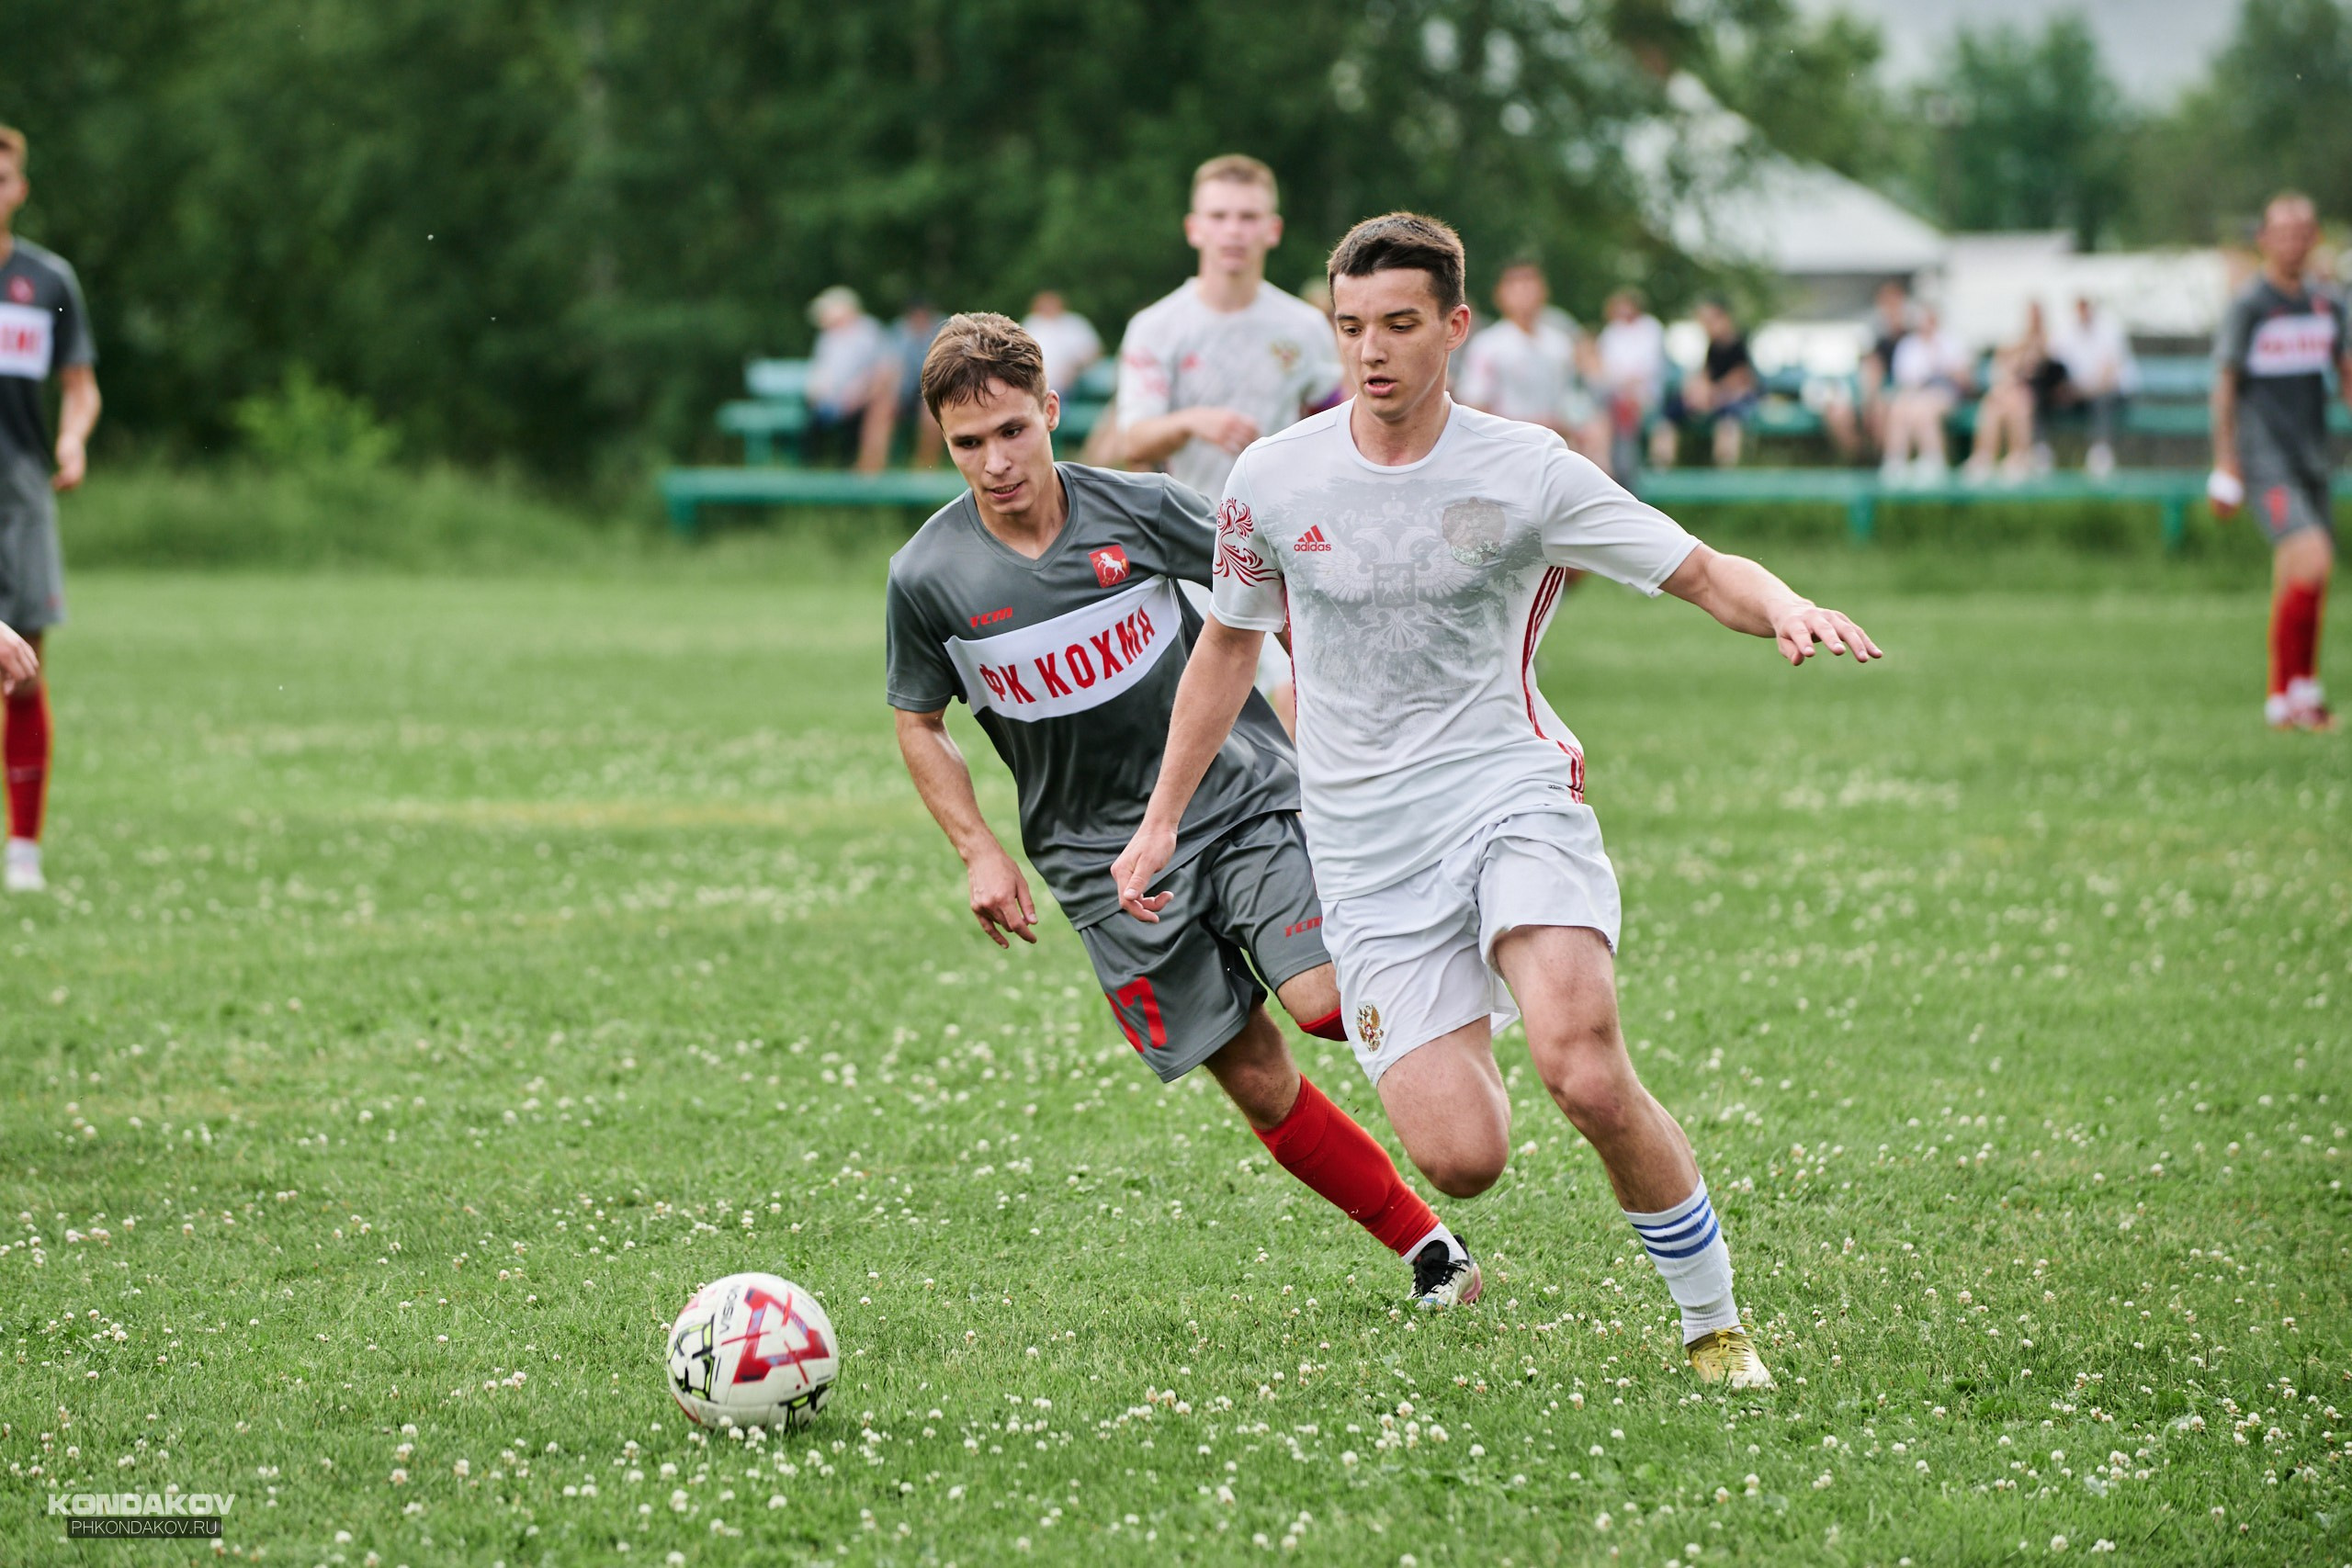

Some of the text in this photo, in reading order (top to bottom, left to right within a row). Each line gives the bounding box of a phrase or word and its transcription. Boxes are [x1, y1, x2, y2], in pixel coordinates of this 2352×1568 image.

[1293, 541, 1332, 552] adidas
[979, 604, 1156, 705] ФК КОХМА
